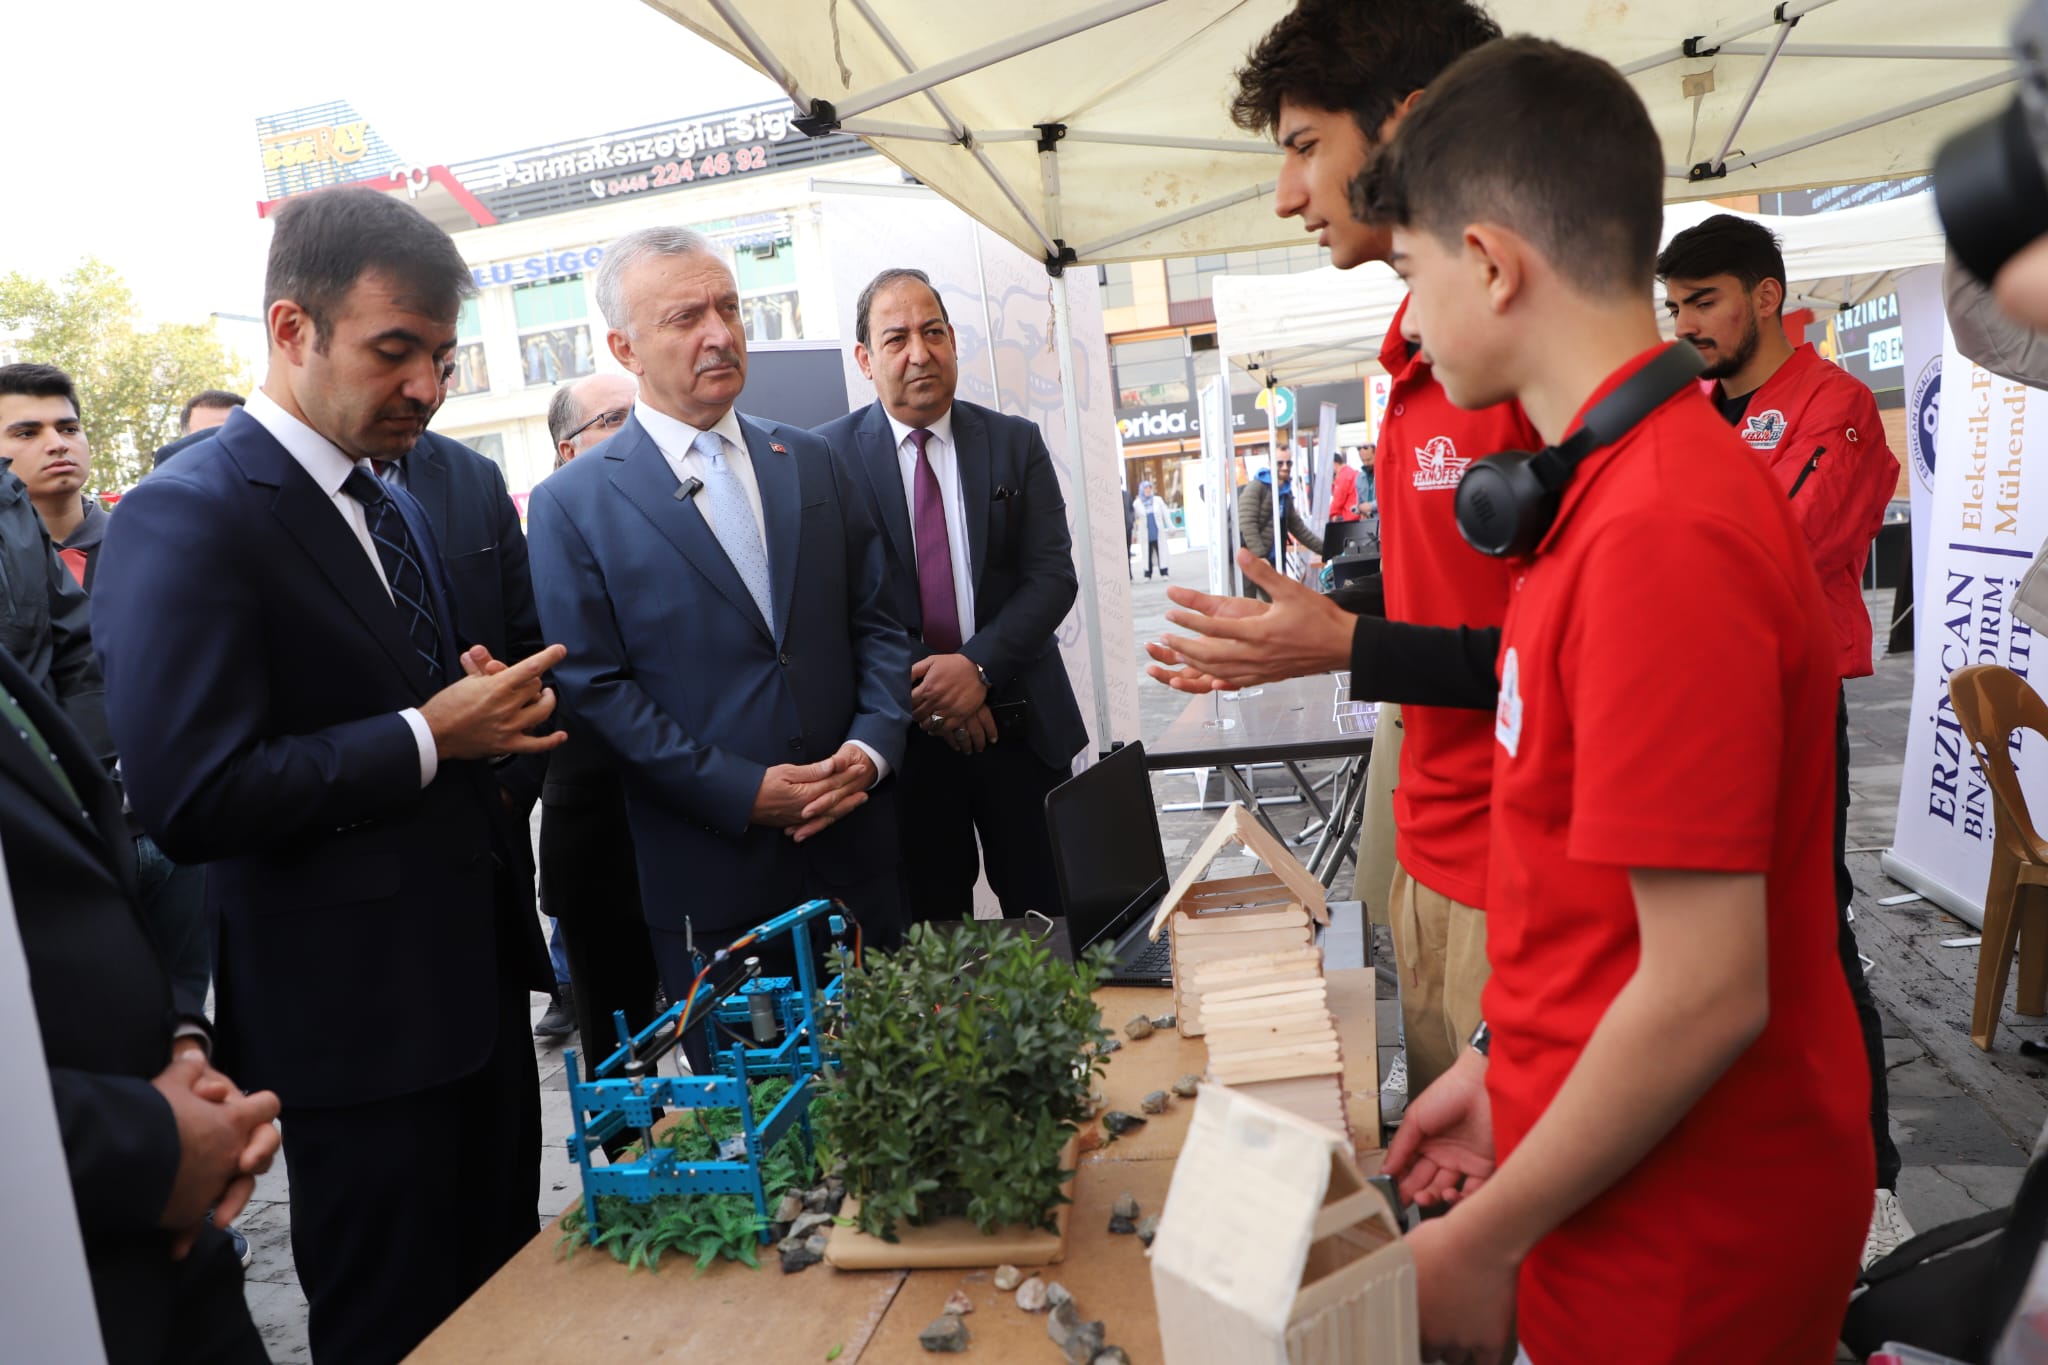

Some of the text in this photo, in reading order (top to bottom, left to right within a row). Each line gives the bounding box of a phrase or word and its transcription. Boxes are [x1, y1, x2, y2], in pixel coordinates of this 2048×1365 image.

[651, 159, 695, 188] 224
[700, 151, 730, 178] 46
[735, 145, 768, 172] 92
[1873, 340, 1887, 364] 28
